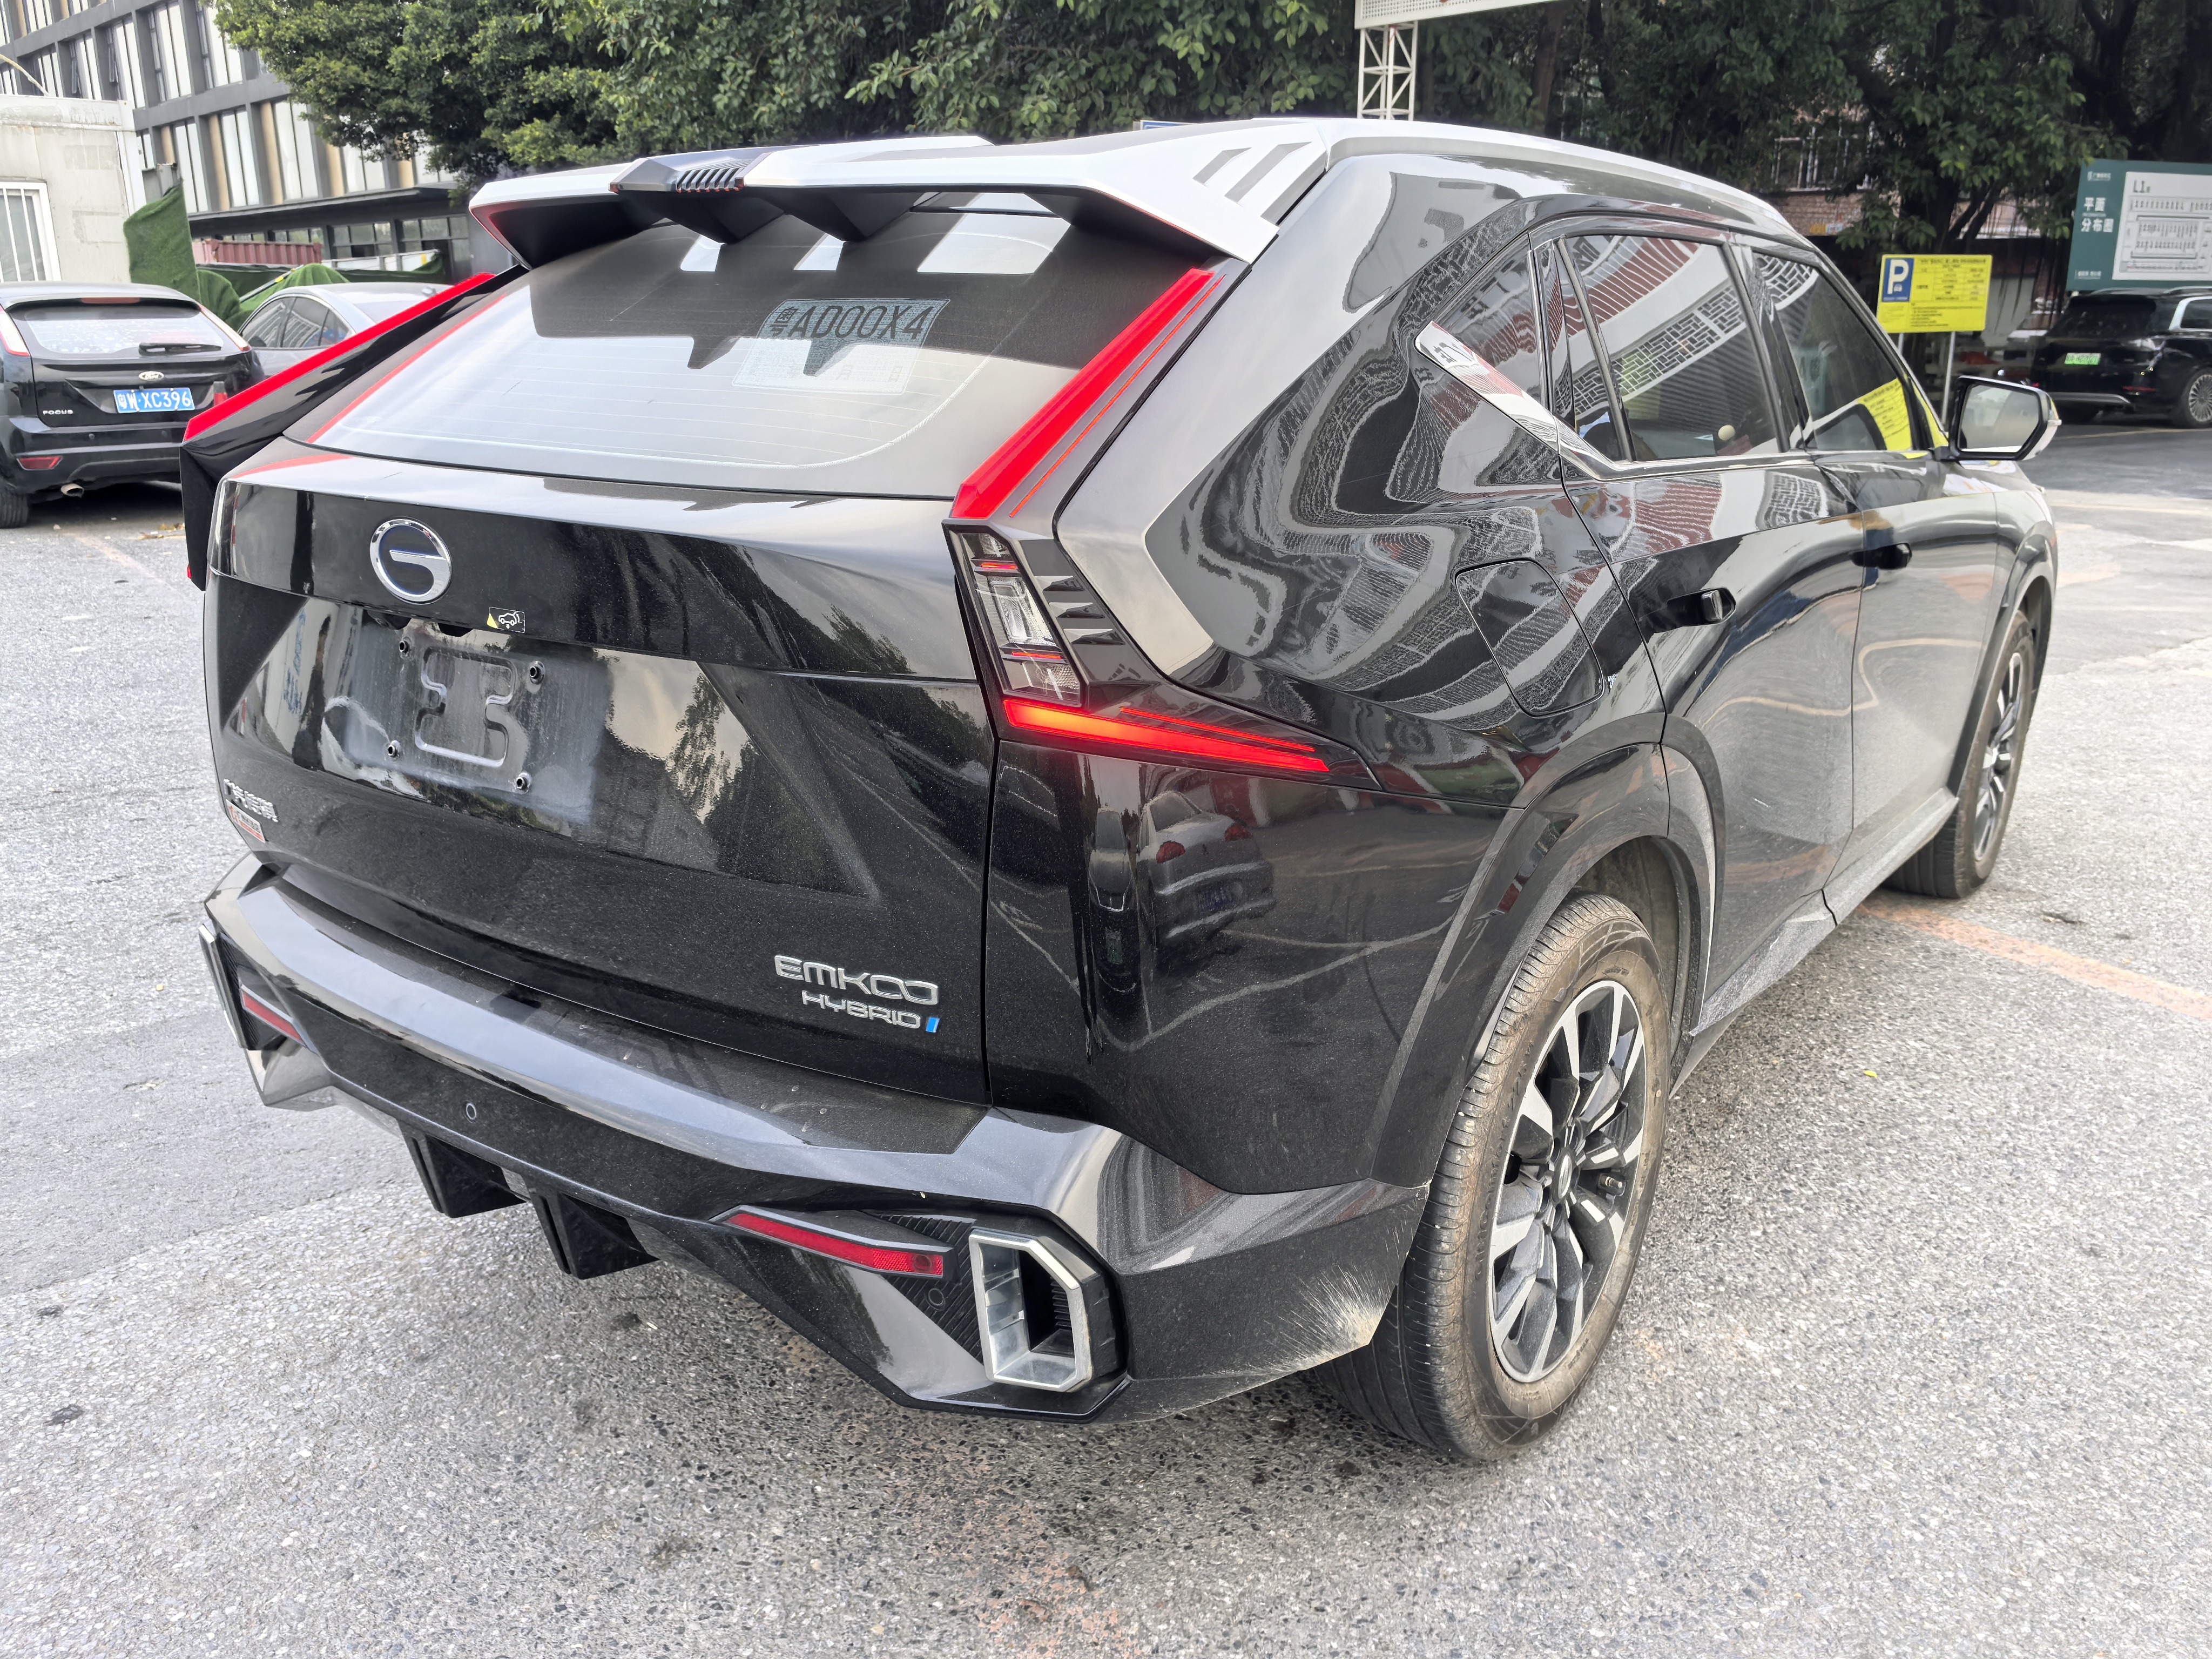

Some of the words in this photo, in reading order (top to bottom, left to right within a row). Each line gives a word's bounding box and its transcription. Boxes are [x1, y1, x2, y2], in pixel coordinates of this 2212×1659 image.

[2083, 197, 2106, 212] 平面
[1887, 259, 1909, 295] P
[774, 955, 939, 1005] EMKOO
[801, 989, 921, 1029] HYBRID
